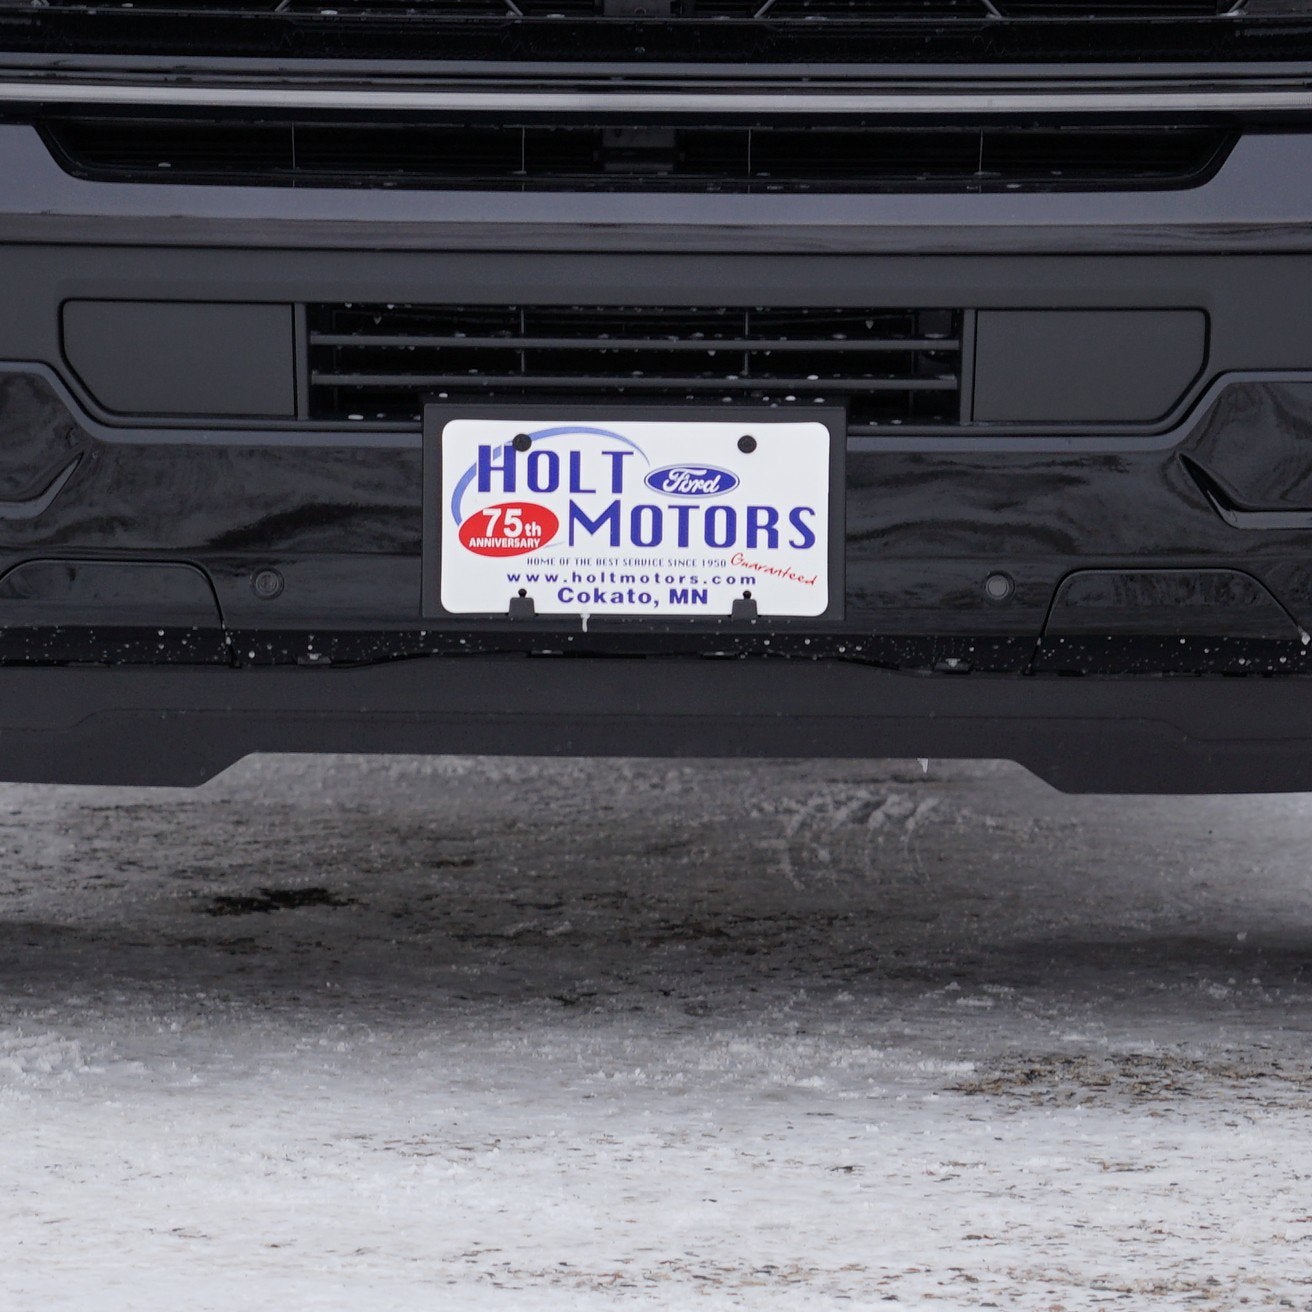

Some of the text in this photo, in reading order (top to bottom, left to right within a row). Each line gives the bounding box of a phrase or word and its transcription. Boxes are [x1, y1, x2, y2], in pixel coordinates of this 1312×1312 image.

[477, 444, 635, 494] HOLT
[661, 466, 719, 495] Ford
[482, 507, 542, 538] 75th
[567, 499, 816, 549] MOTORS
[468, 537, 542, 549] ANNIVERSARY
[526, 557, 727, 568] HOME OF THE BEST SERVICE SINCE 1950
[730, 552, 817, 586] Guaranteed
[506, 571, 757, 585] www.holtmotors.com
[557, 587, 709, 608] Cokato, MN
